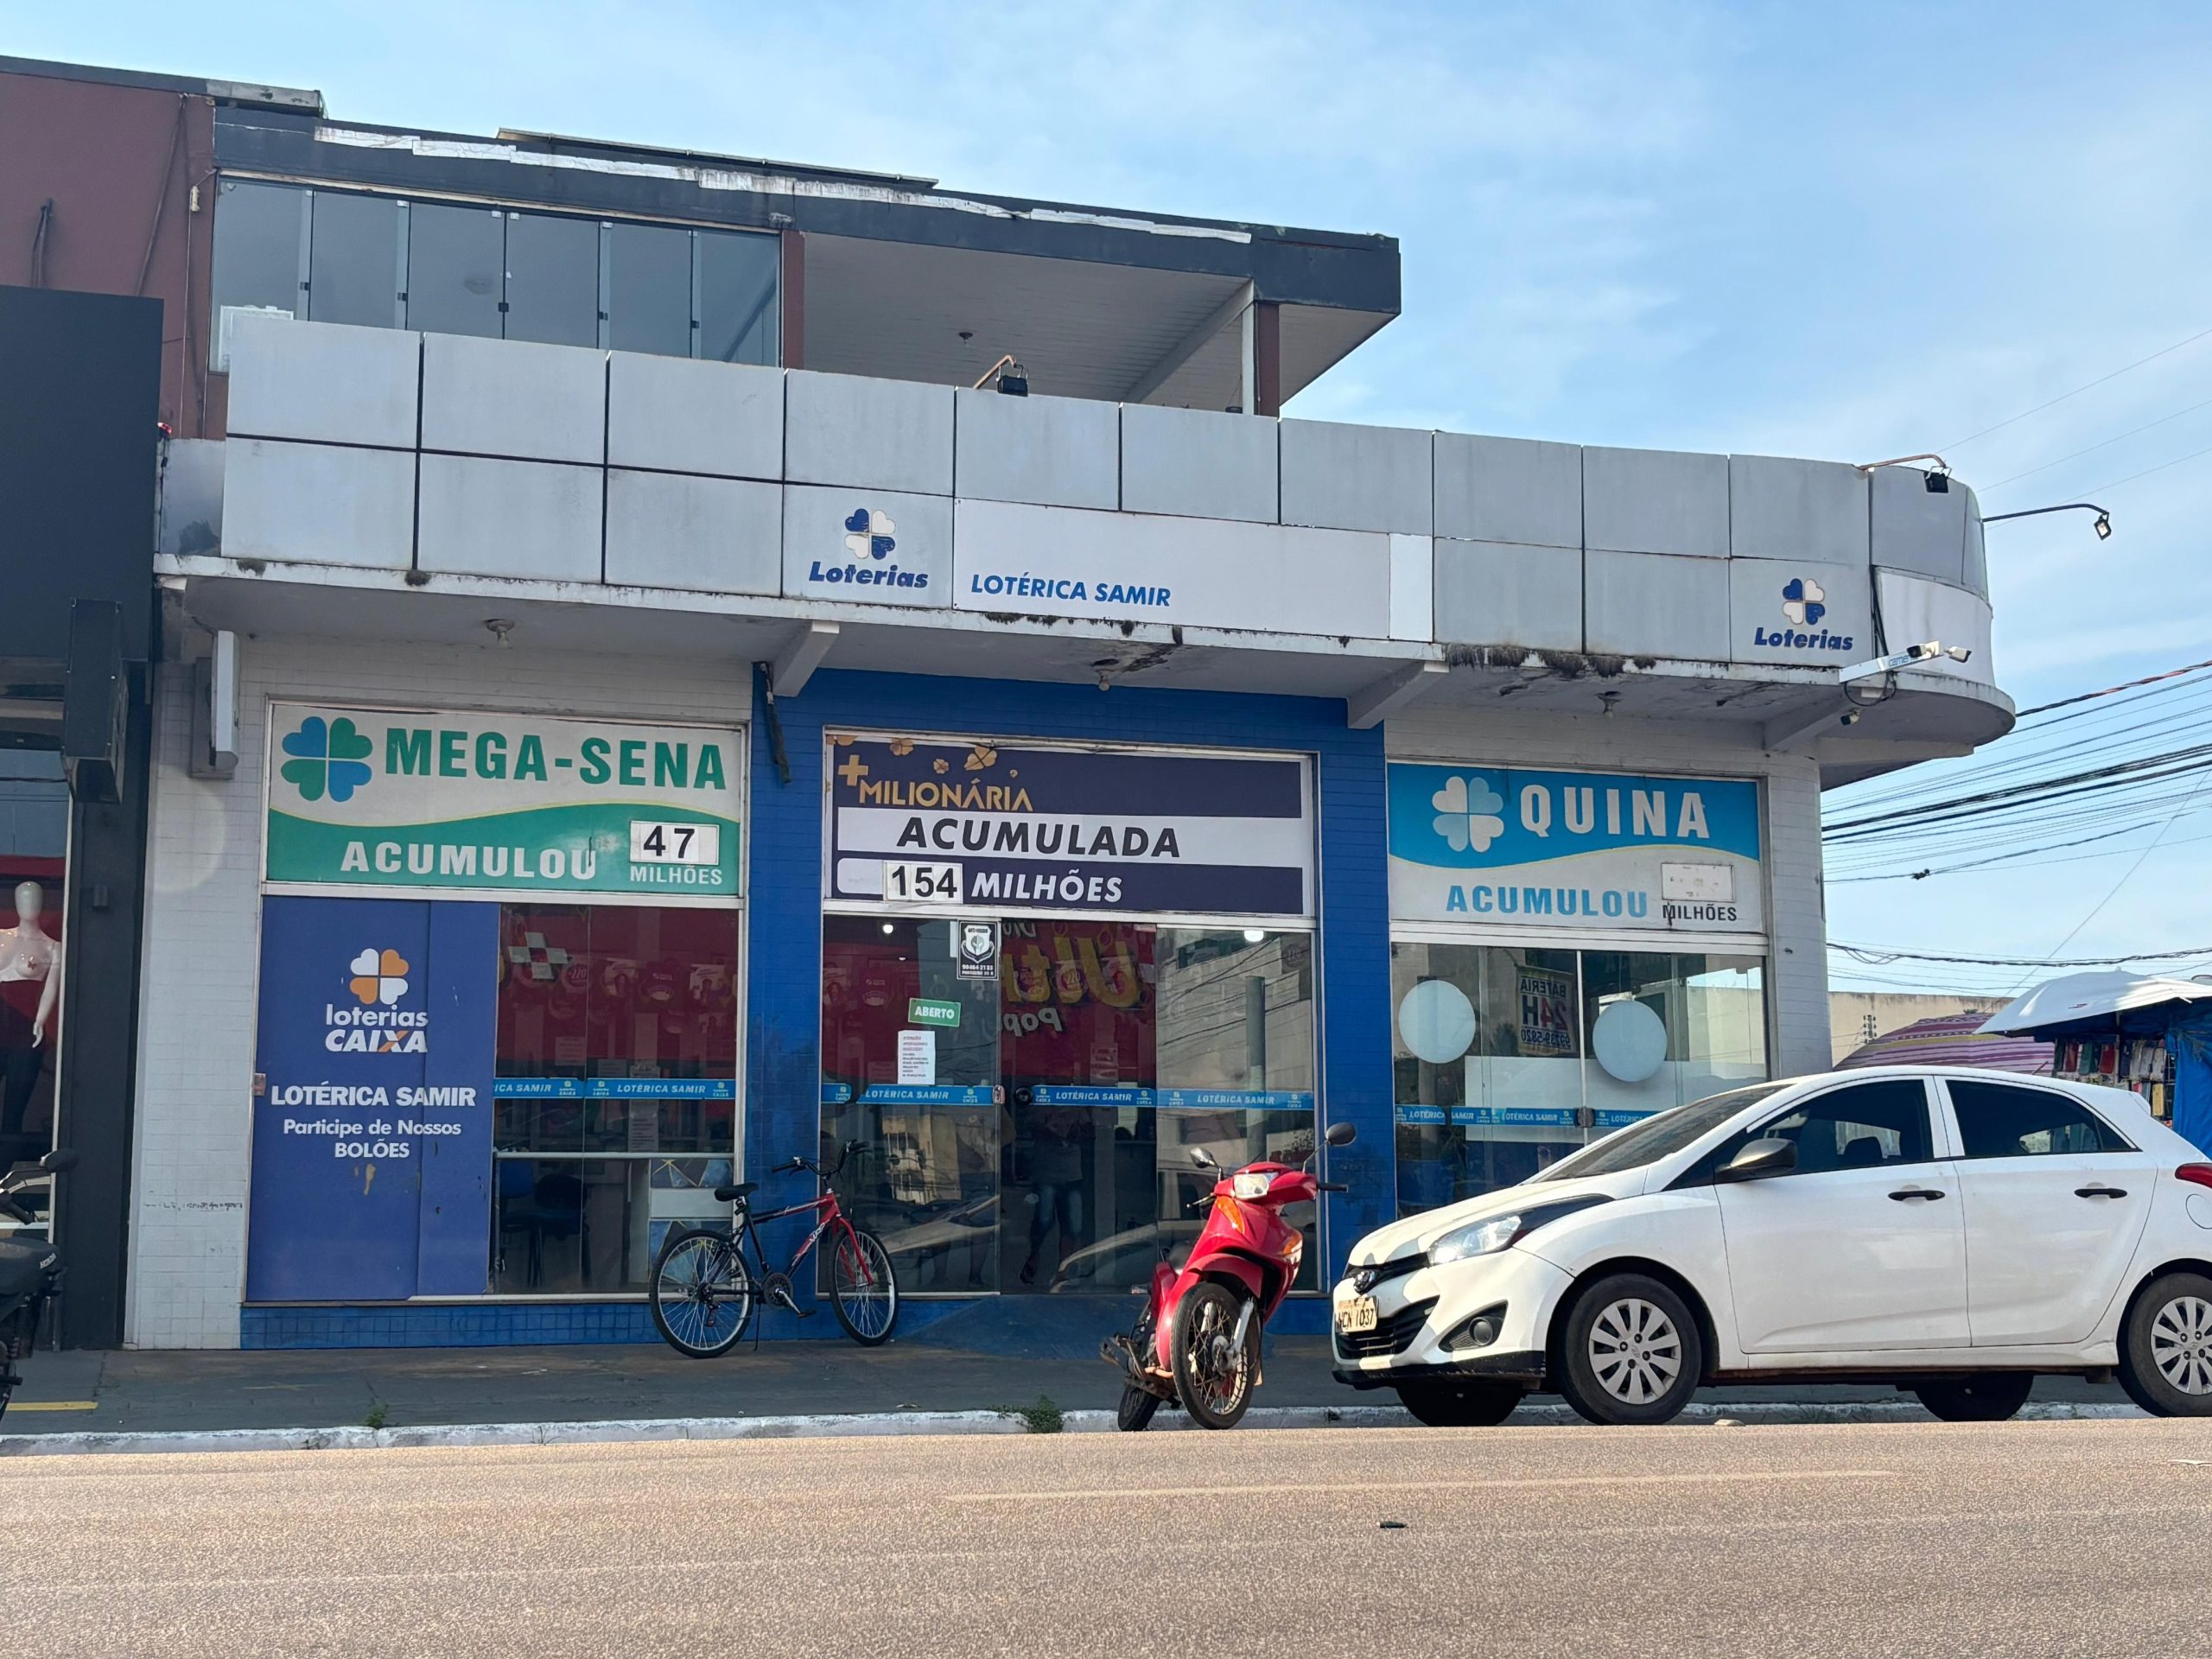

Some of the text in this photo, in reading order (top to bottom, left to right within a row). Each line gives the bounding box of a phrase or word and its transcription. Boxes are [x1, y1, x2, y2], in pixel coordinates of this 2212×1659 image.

[809, 562, 928, 589] Loterias
[971, 572, 1172, 607] LOTÉRICA SAMIR
[1754, 627, 1853, 651] Loterias
[385, 727, 727, 791] MEGA-SENA
[1520, 785, 1710, 839] QUINA
[642, 825, 696, 859] 47
[896, 817, 1180, 858] ACUMULADA
[340, 841, 597, 880] ACUMULOU
[630, 864, 722, 886] MILHÕES
[891, 865, 1122, 903] 154 MILHÕES
[1446, 885, 1648, 918] ACUMULOU
[1662, 902, 1738, 922] MILHÕES
[326, 1003, 429, 1027] loterias
[914, 1006, 955, 1020] ABERTO
[325, 1029, 428, 1053] CAIXA
[271, 1080, 476, 1107] LOTÉRICA SAMIR
[516, 1084, 552, 1093] SAMIR
[617, 1083, 669, 1093] LOTÉRICA
[671, 1084, 706, 1094] SAMIR
[865, 1089, 949, 1100] LOTÉRICA SAMIR
[1056, 1090, 1132, 1102] LOTÉRICA SAMIR
[1198, 1092, 1275, 1105] LOTÉRICA SAMIR
[283, 1119, 461, 1138] Participe de Nossos
[334, 1138, 410, 1158] BOLÕES
[1356, 1308, 1375, 1327] 1037
